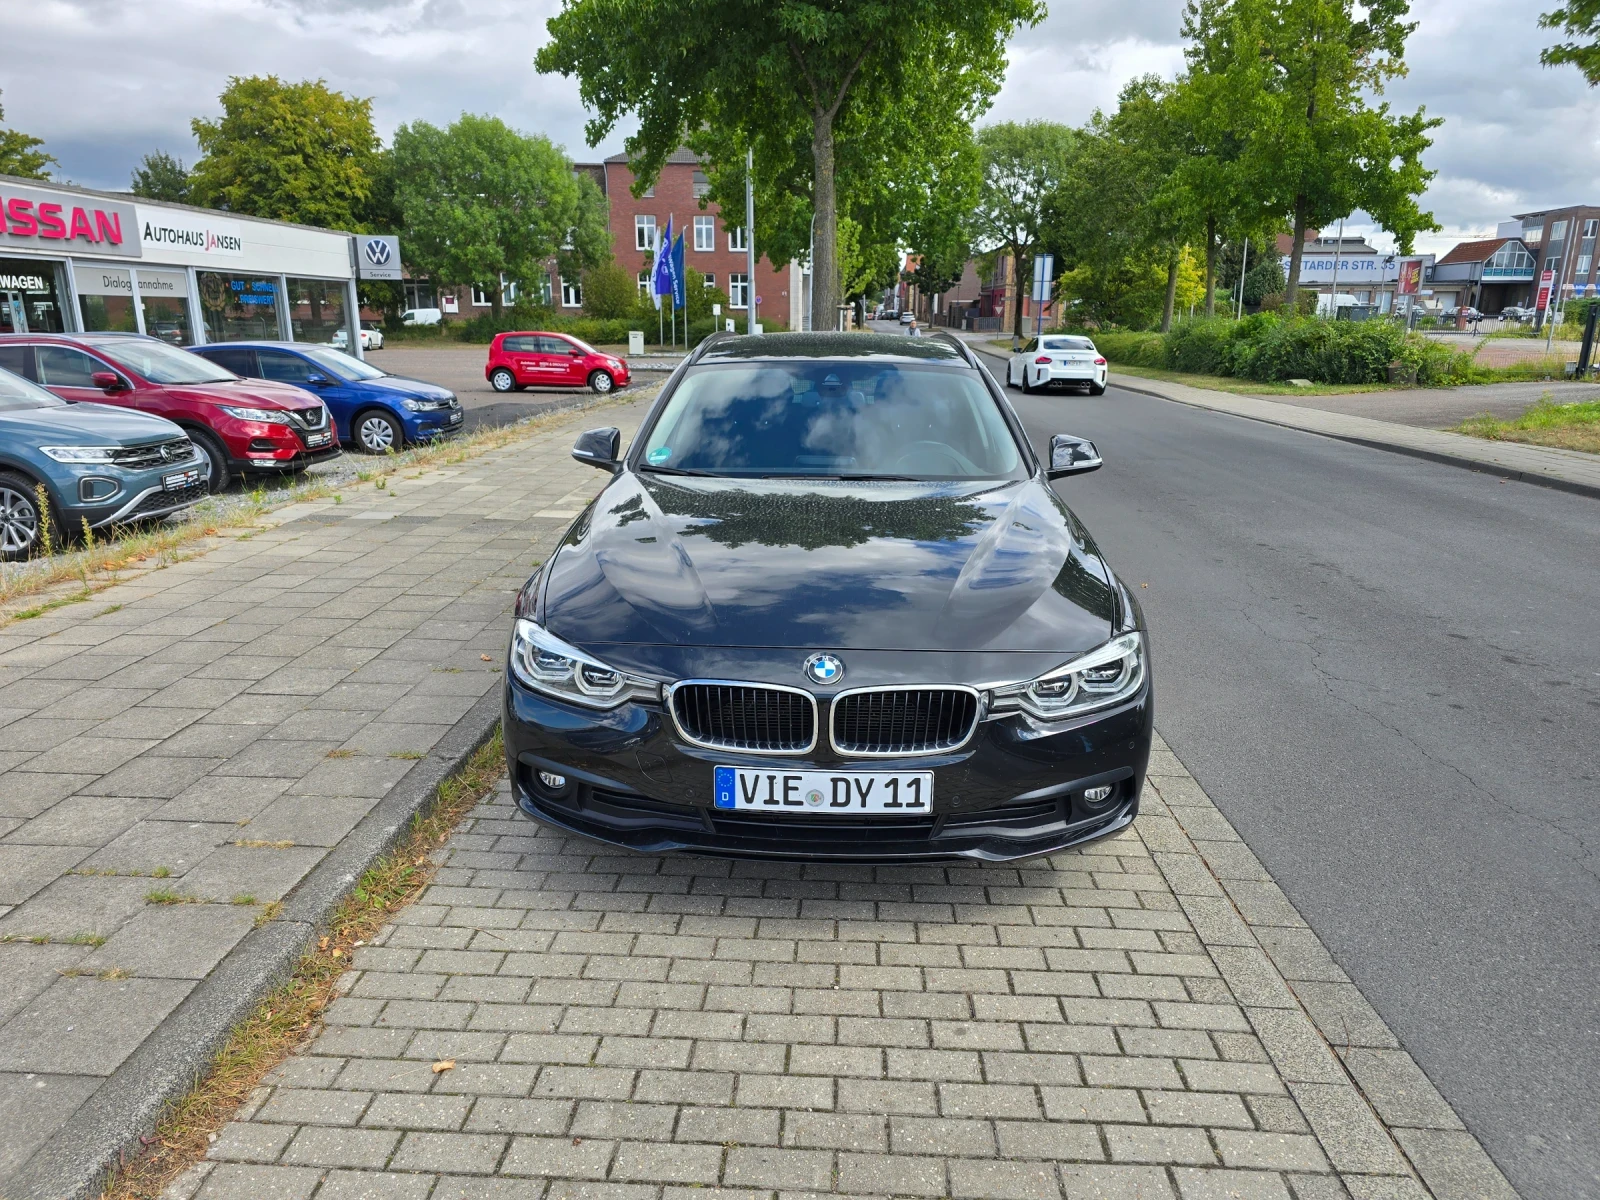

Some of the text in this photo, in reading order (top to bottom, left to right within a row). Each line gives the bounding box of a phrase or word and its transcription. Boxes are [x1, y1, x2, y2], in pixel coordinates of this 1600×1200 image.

[143, 221, 241, 252] AUTOHAUS JANSEN
[1284, 260, 1349, 270] STARDER
[1351, 260, 1377, 270] STR.
[230, 280, 245, 291] GUT
[721, 791, 729, 801] D
[739, 773, 926, 808] VIE DY 11
